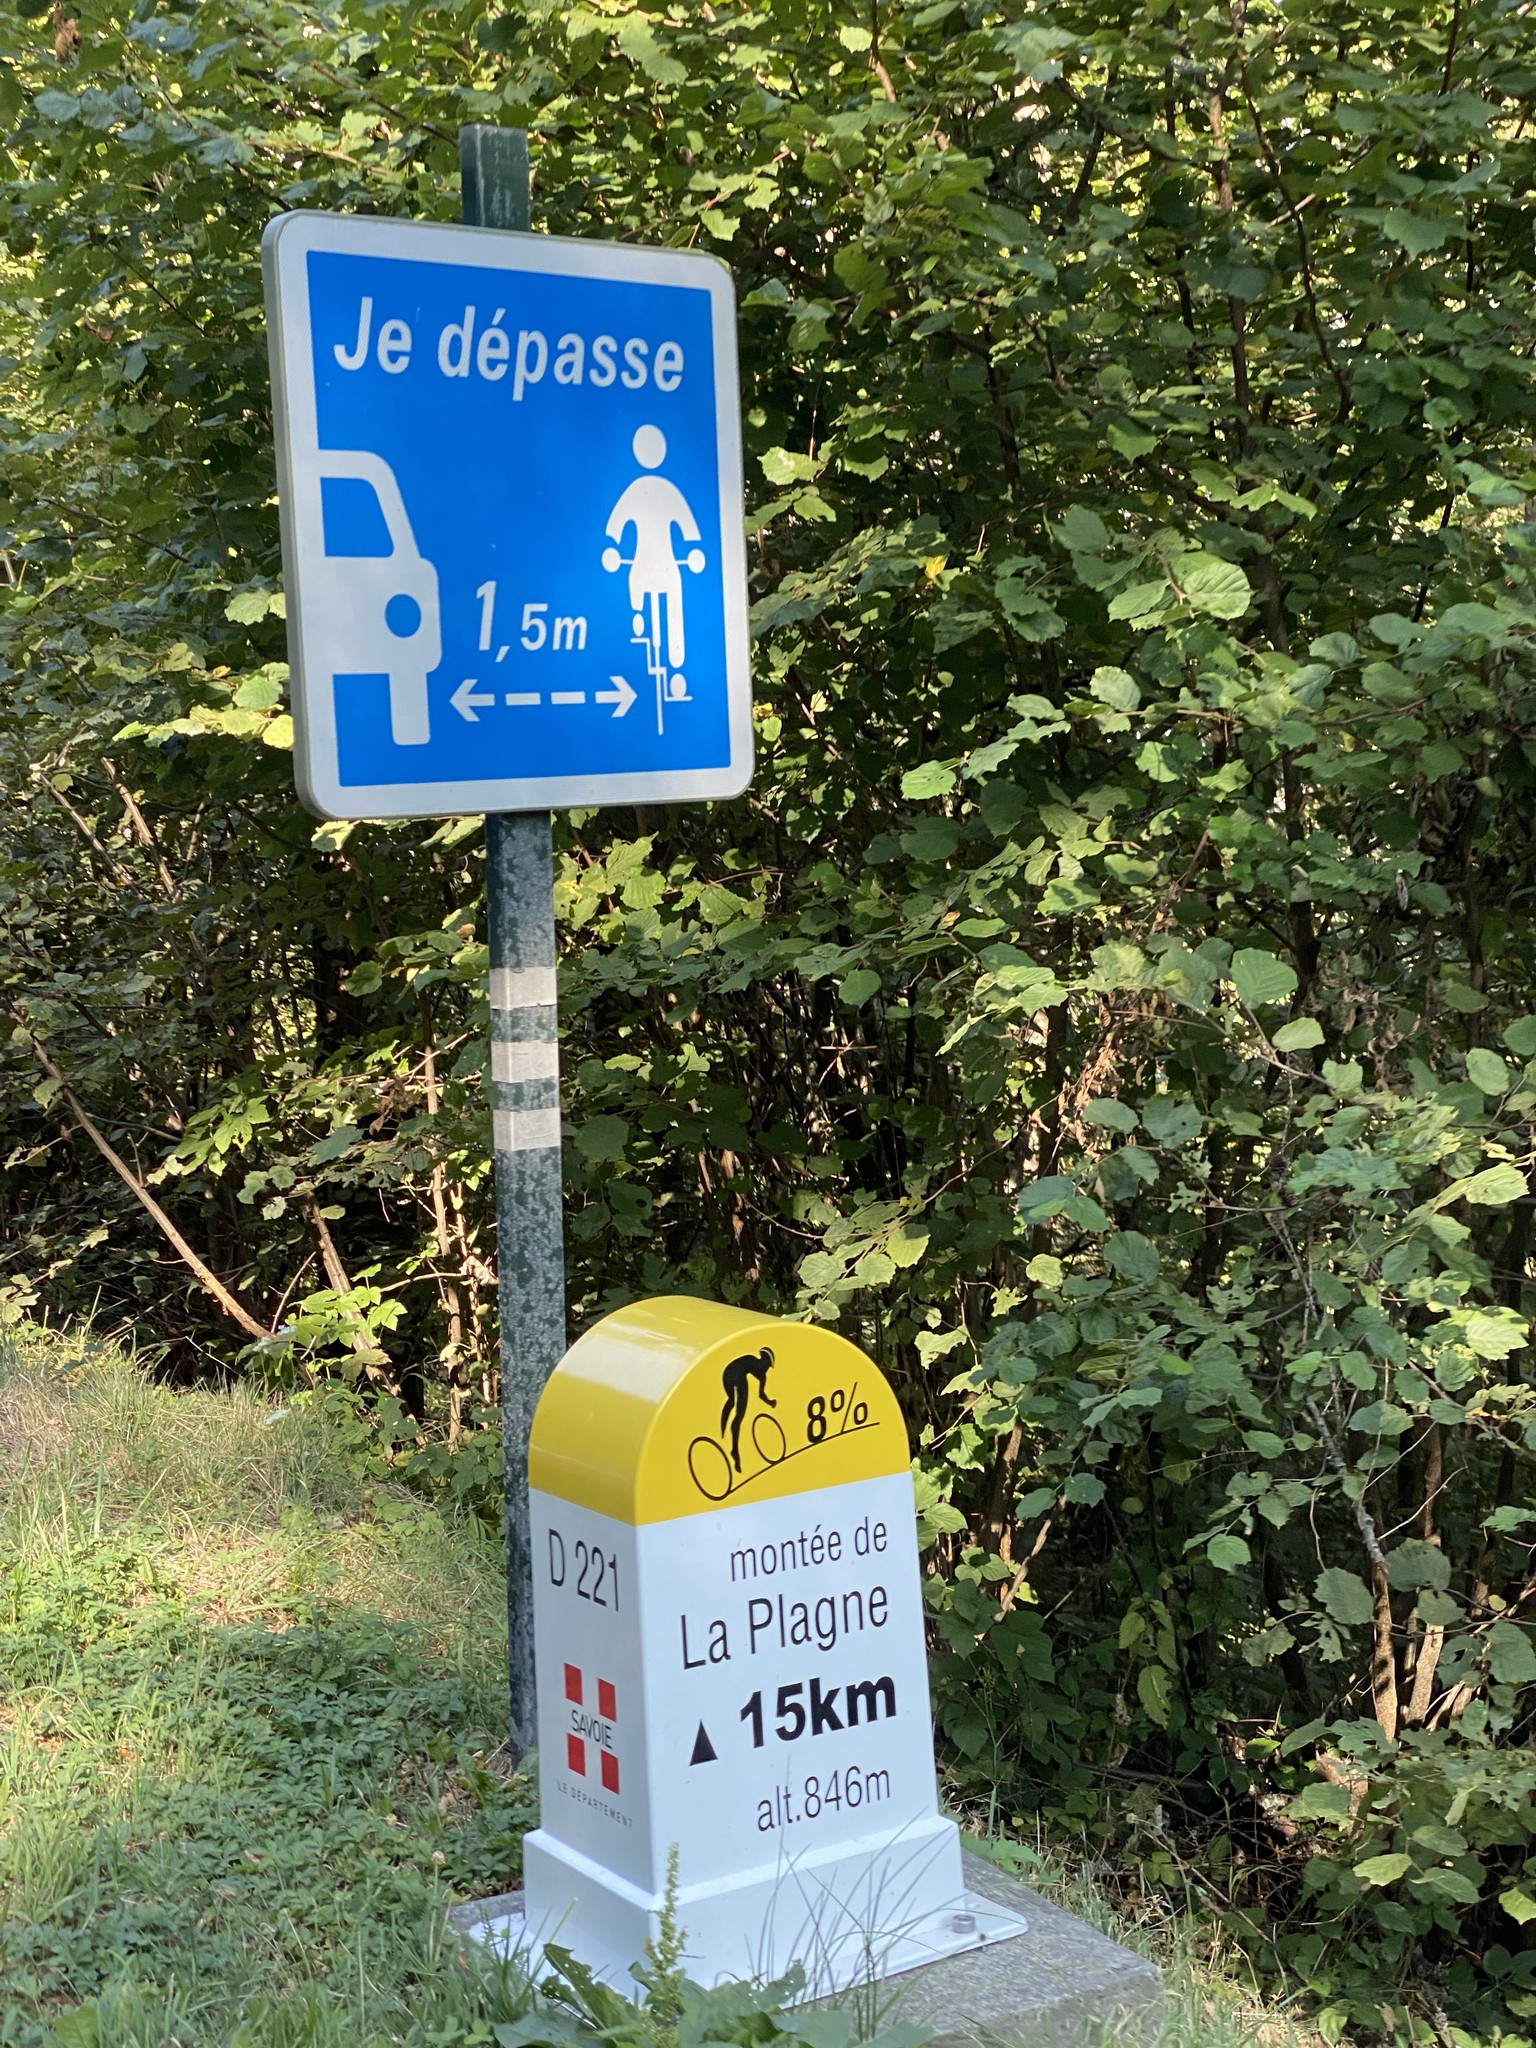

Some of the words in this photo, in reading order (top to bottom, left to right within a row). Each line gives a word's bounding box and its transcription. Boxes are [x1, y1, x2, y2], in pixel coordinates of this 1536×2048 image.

[334, 296, 412, 375] Je
[437, 305, 685, 402] dépasse
[805, 1381, 869, 1444] 8%
[548, 1528, 566, 1587] D
[575, 1540, 620, 1612] 221
[730, 1523, 844, 1581] montée
[855, 1517, 888, 1557] de
[681, 1614, 731, 1670] La
[747, 1585, 889, 1655] Plagne
[571, 1709, 613, 1750] SAVOIE
[739, 1675, 897, 1750] 15km
[556, 1780, 568, 1795] LE
[571, 1785, 633, 1828] DÉPARTEMENT
[757, 1767, 891, 1832] alt.846m
